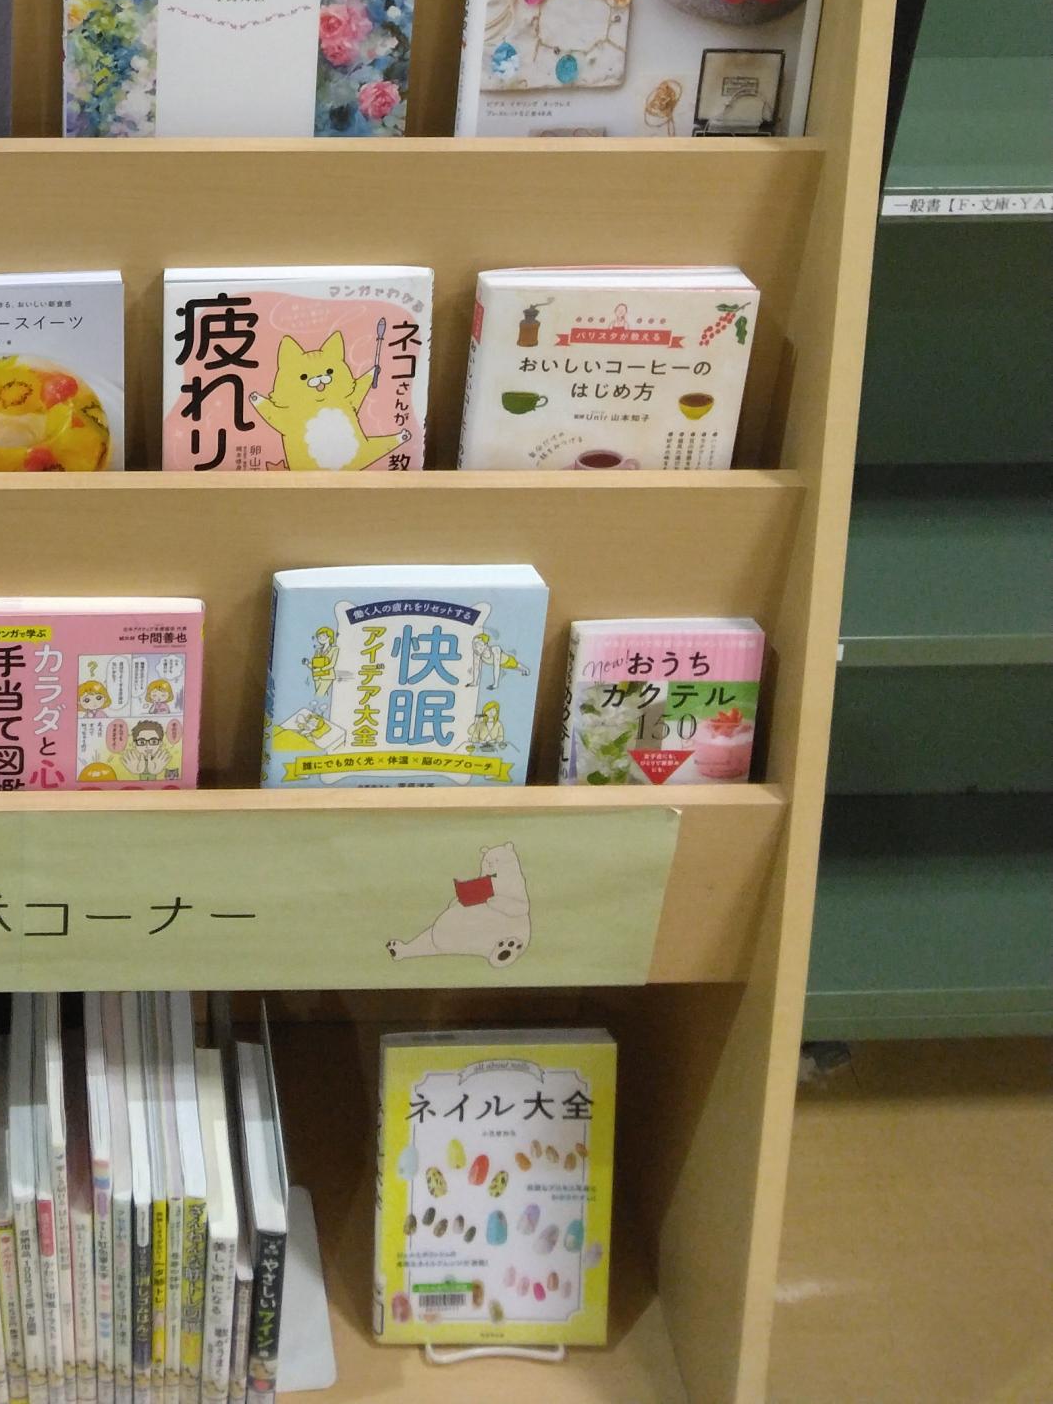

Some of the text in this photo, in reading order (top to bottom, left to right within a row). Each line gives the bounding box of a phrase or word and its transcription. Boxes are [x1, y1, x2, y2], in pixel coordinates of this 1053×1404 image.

[576, 331, 661, 342] バリスタが教える
[518, 356, 712, 376] おいしいコーヒーの
[570, 382, 655, 402] はじめ方
[250, 445, 262, 471] 卵山
[352, 602, 472, 621] 働く人の疲れをリセットする
[137, 632, 187, 644] 中間善也
[627, 652, 710, 677] おうち
[351, 625, 387, 747] アイデア大全
[385, 624, 462, 747] 快眠
[601, 683, 736, 709] カクテル
[29, 644, 65, 790] カラダと心
[405, 1090, 595, 1124] ネイル大全
